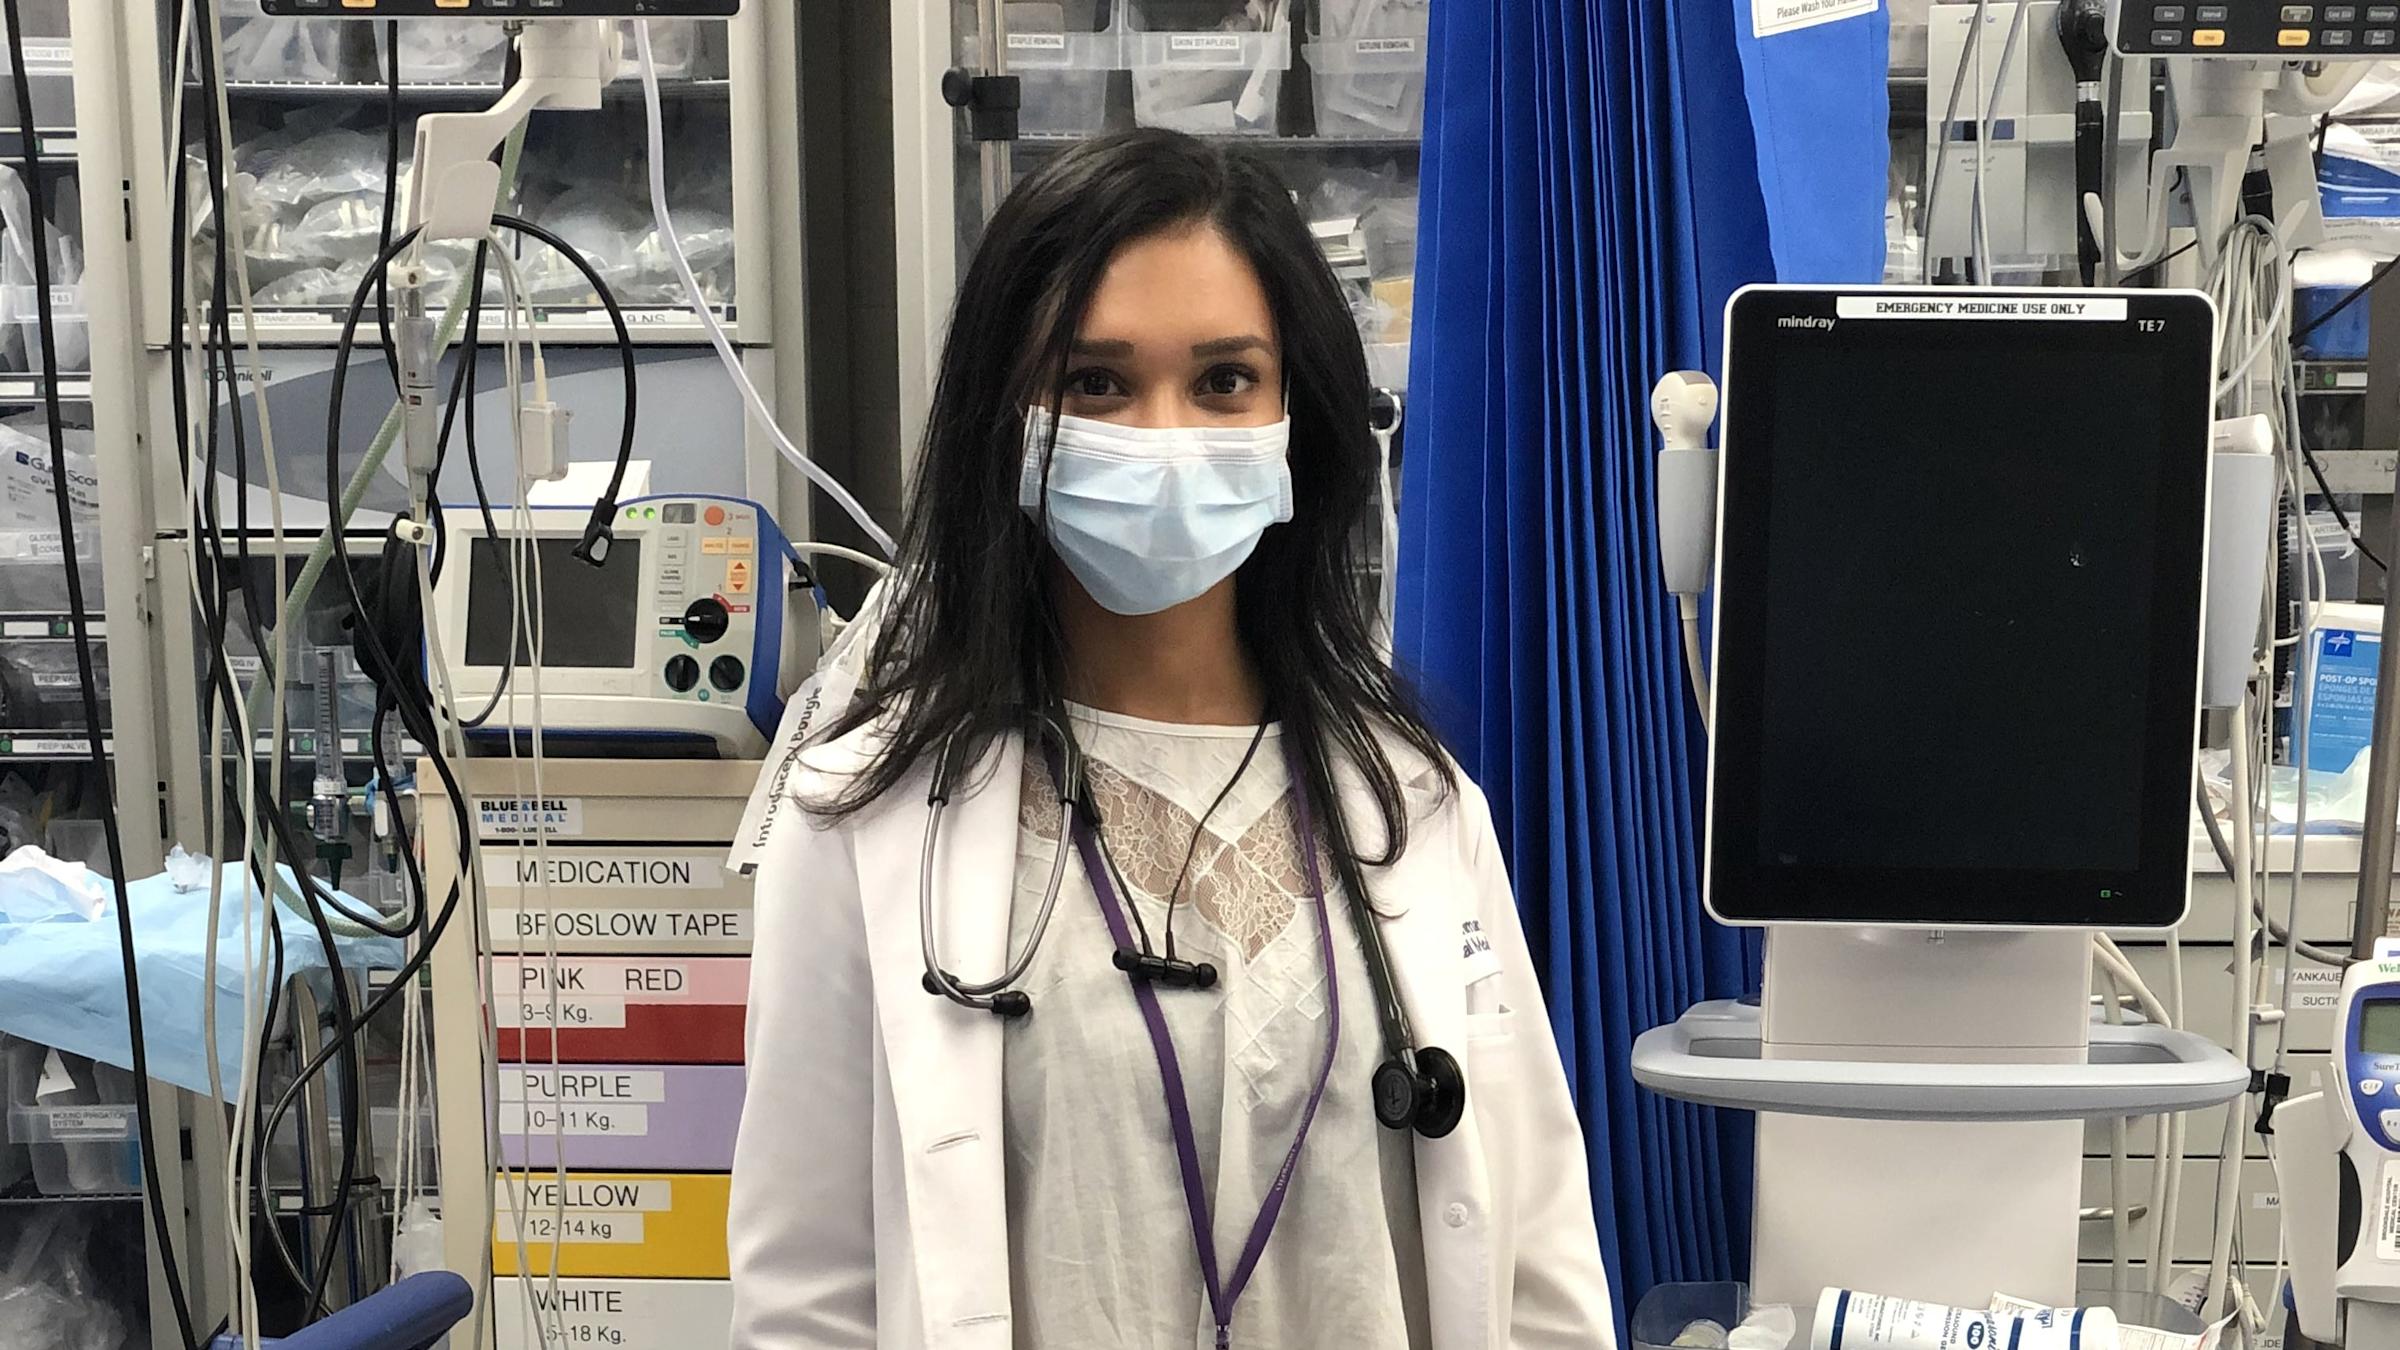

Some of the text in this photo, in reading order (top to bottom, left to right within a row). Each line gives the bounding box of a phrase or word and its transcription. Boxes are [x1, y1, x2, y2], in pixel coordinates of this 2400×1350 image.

[1777, 6, 1799, 18] Please
[1801, 3, 1820, 13] Wash
[1876, 303, 2085, 315] EMERGENCY MEDICINE USE ONLY
[1777, 315, 1836, 332] mindray
[2320, 674, 2357, 684] POST-OP
[481, 801, 518, 811] BLUE
[482, 813, 566, 823] MEDICAL
[516, 861, 690, 884] MEDICATION
[666, 914, 738, 936] TAPE
[625, 969, 683, 991] RED
[563, 1004, 593, 1023] Kg.
[525, 1075, 632, 1097] PURPLE
[585, 1111, 615, 1131] Kg.
[528, 1184, 639, 1207] YELLOW
[591, 1219, 612, 1239] kg
[536, 1290, 623, 1312] WHITE
[597, 1325, 627, 1344] Kg.
[1970, 1325, 1982, 1345] 100
